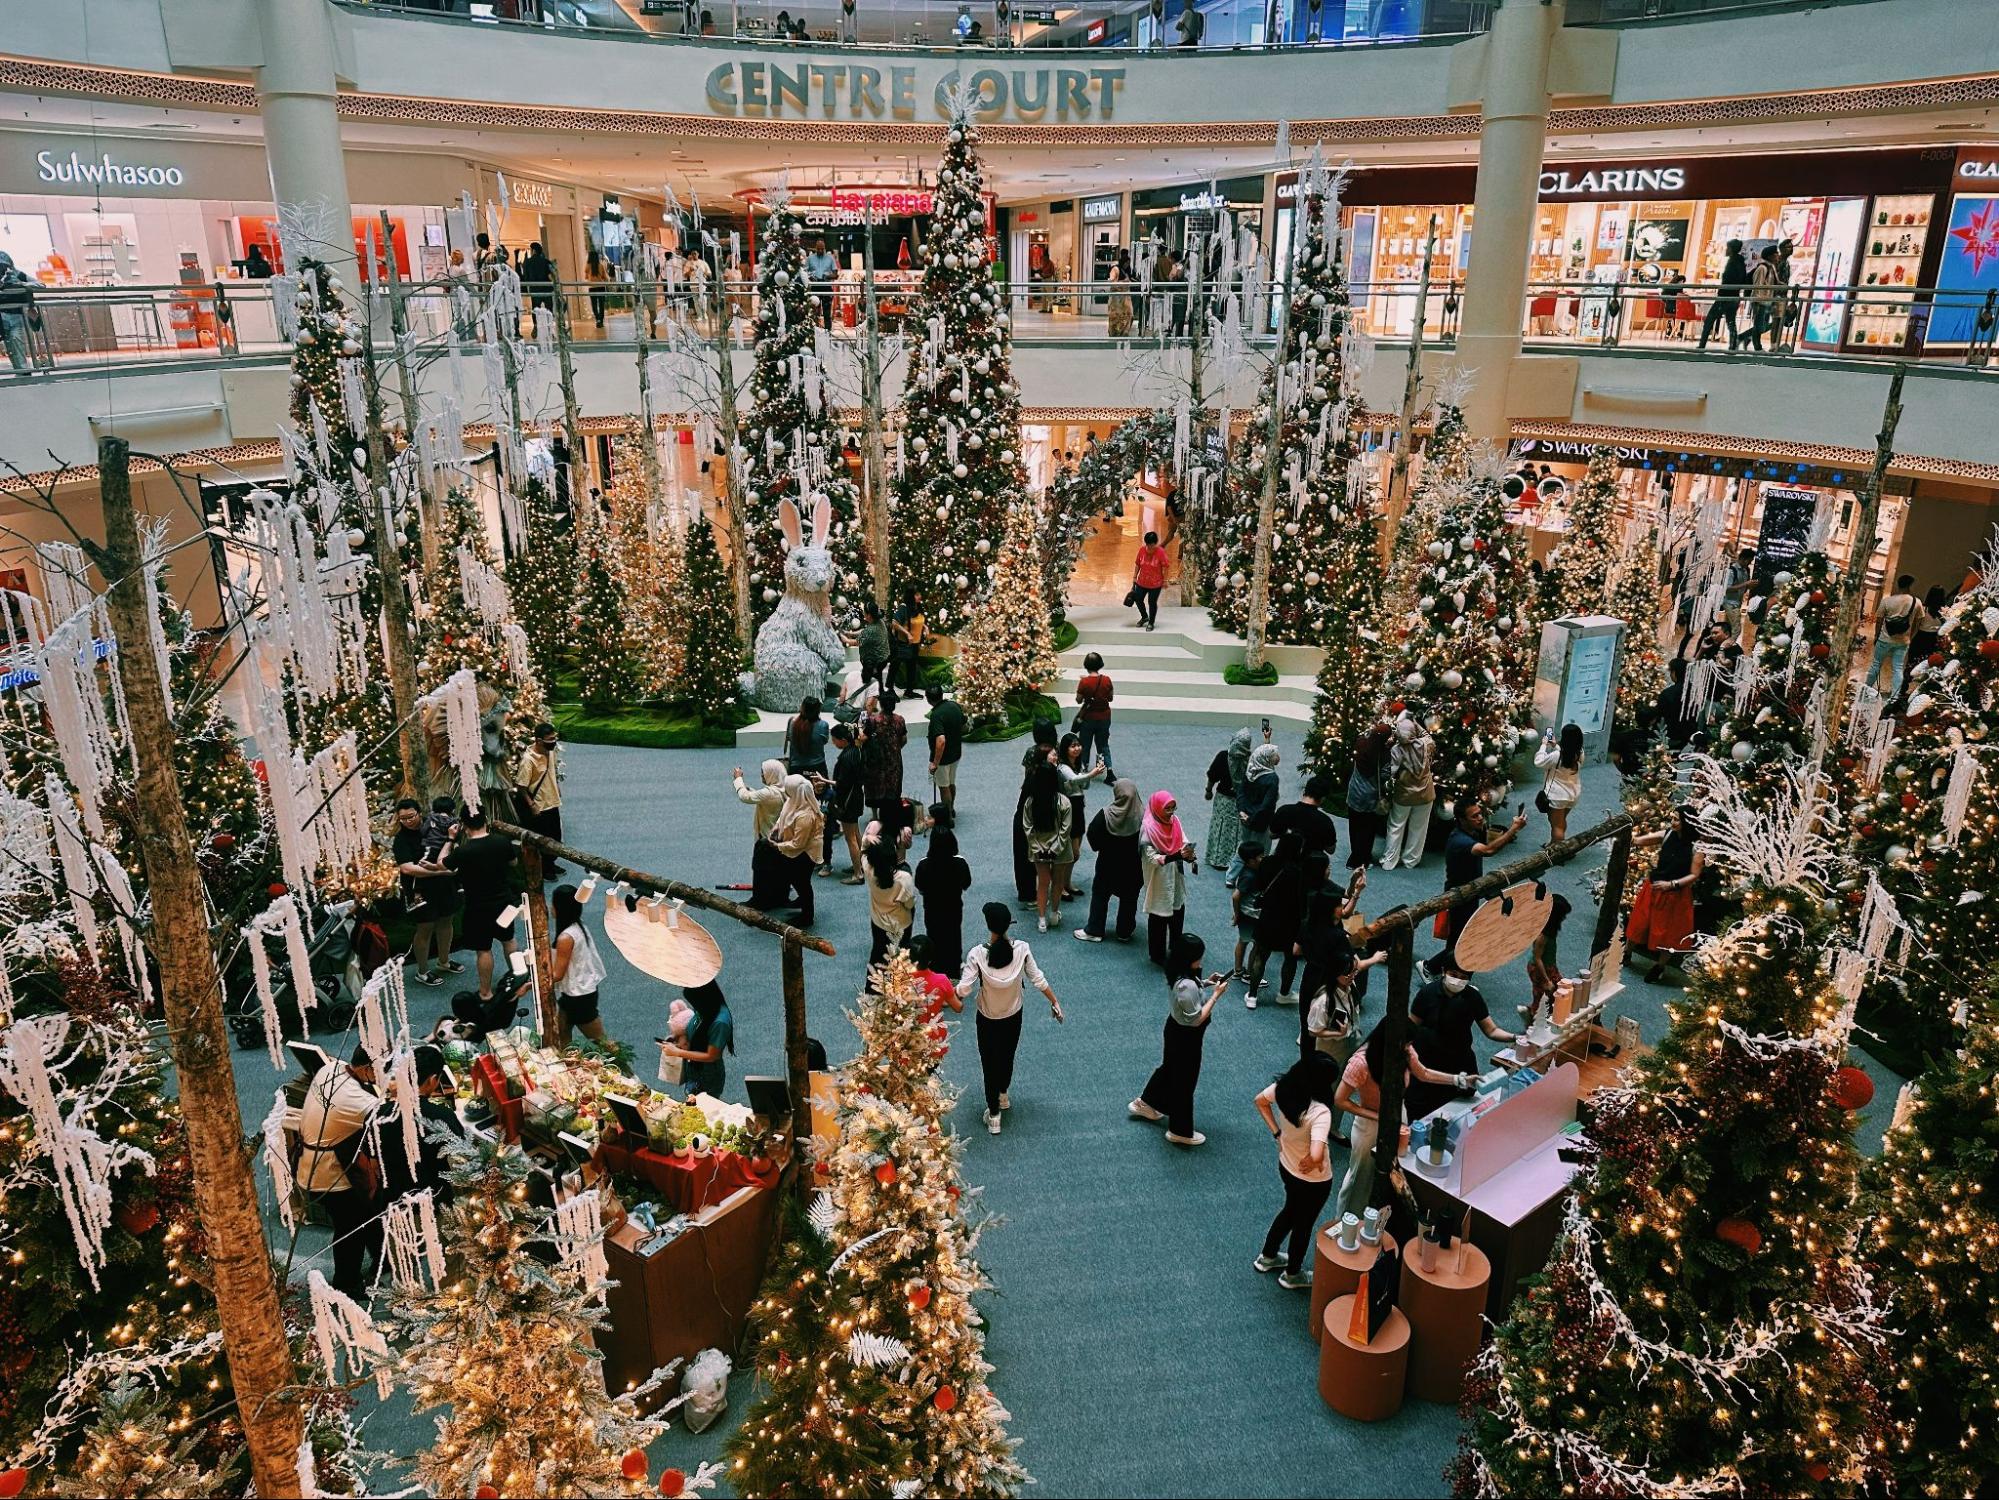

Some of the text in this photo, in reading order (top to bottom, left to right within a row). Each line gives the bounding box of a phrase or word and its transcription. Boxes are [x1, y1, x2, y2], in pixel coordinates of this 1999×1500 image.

[705, 62, 1126, 112] CENTRE COURT
[37, 151, 183, 186] Sulwhasoo
[1538, 168, 1685, 194] CLARINS
[1768, 489, 1815, 501] SWAROVSKI
